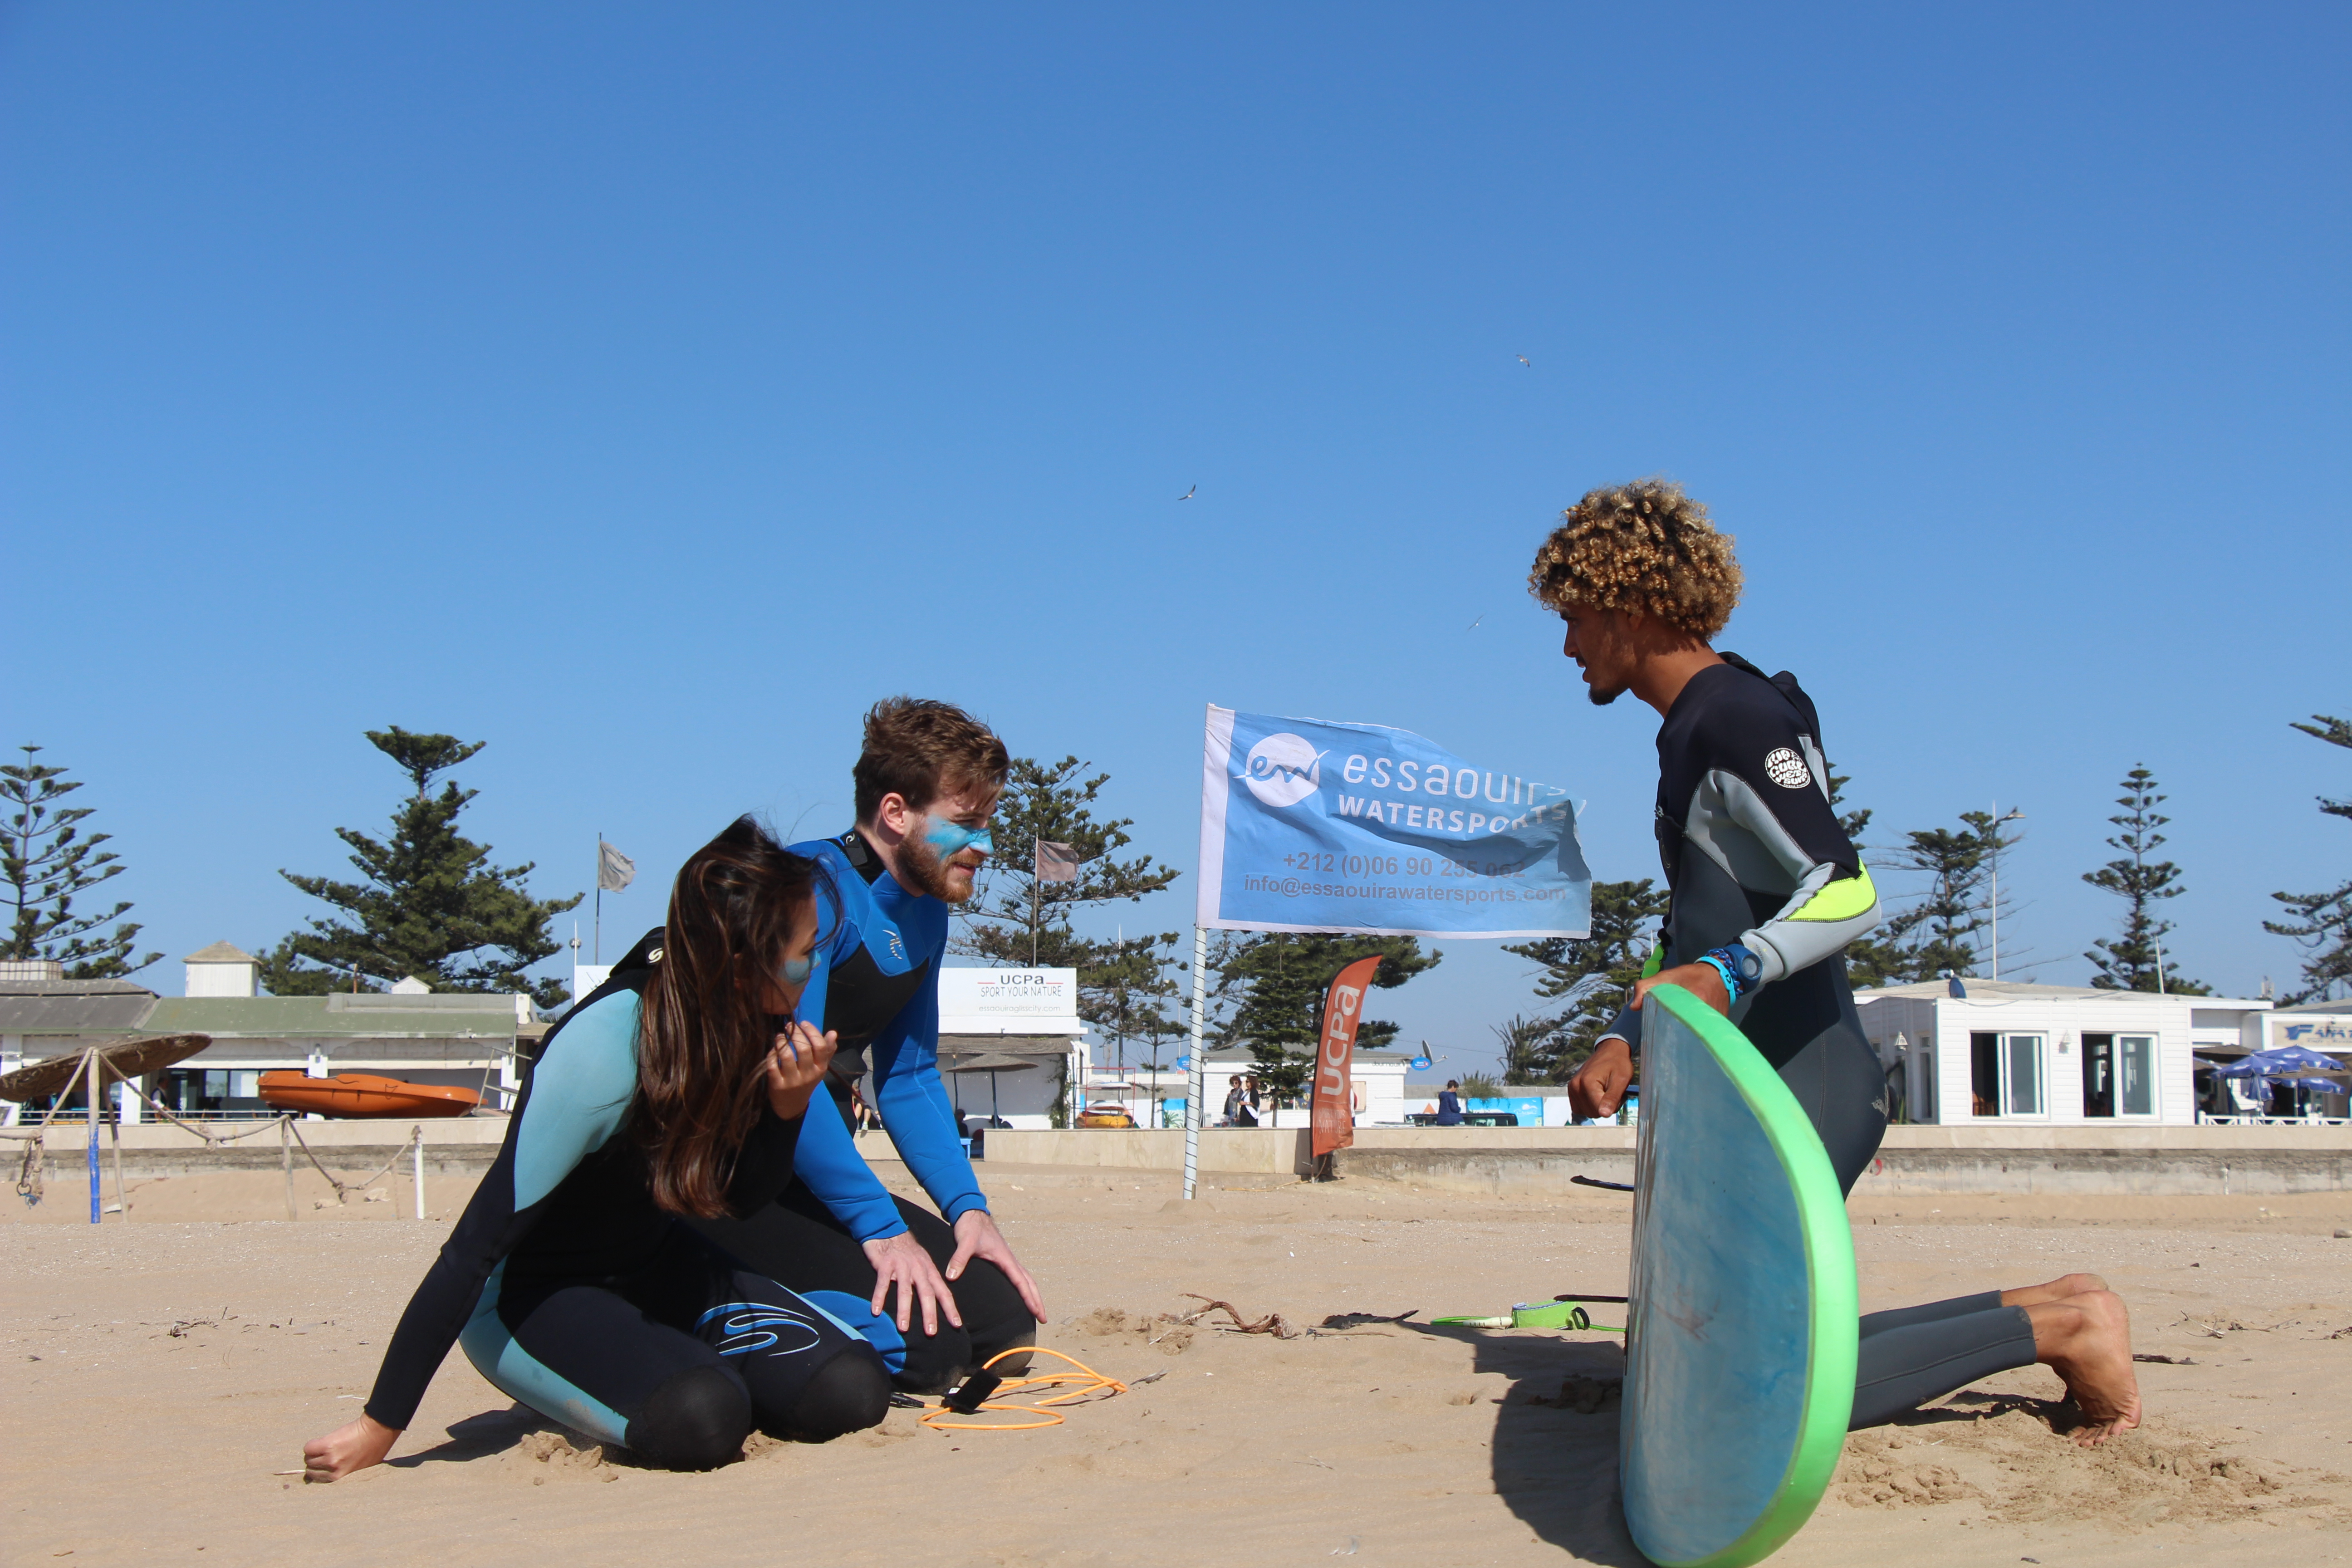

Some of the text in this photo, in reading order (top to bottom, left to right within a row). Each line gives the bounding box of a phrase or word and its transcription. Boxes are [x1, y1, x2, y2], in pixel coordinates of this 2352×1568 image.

[1767, 749, 1791, 768] RIP
[1769, 760, 1807, 778] CURL
[1283, 852, 1526, 879] +212 (0)06 90 255 062
[1244, 874, 1566, 905] info@essaouirawatersports.com
[980, 985, 1061, 997] SPORT YOUR NATURE
[979, 1005, 1061, 1013] essaouiraglisscity.com
[1317, 1119, 1346, 1134] NATURE
